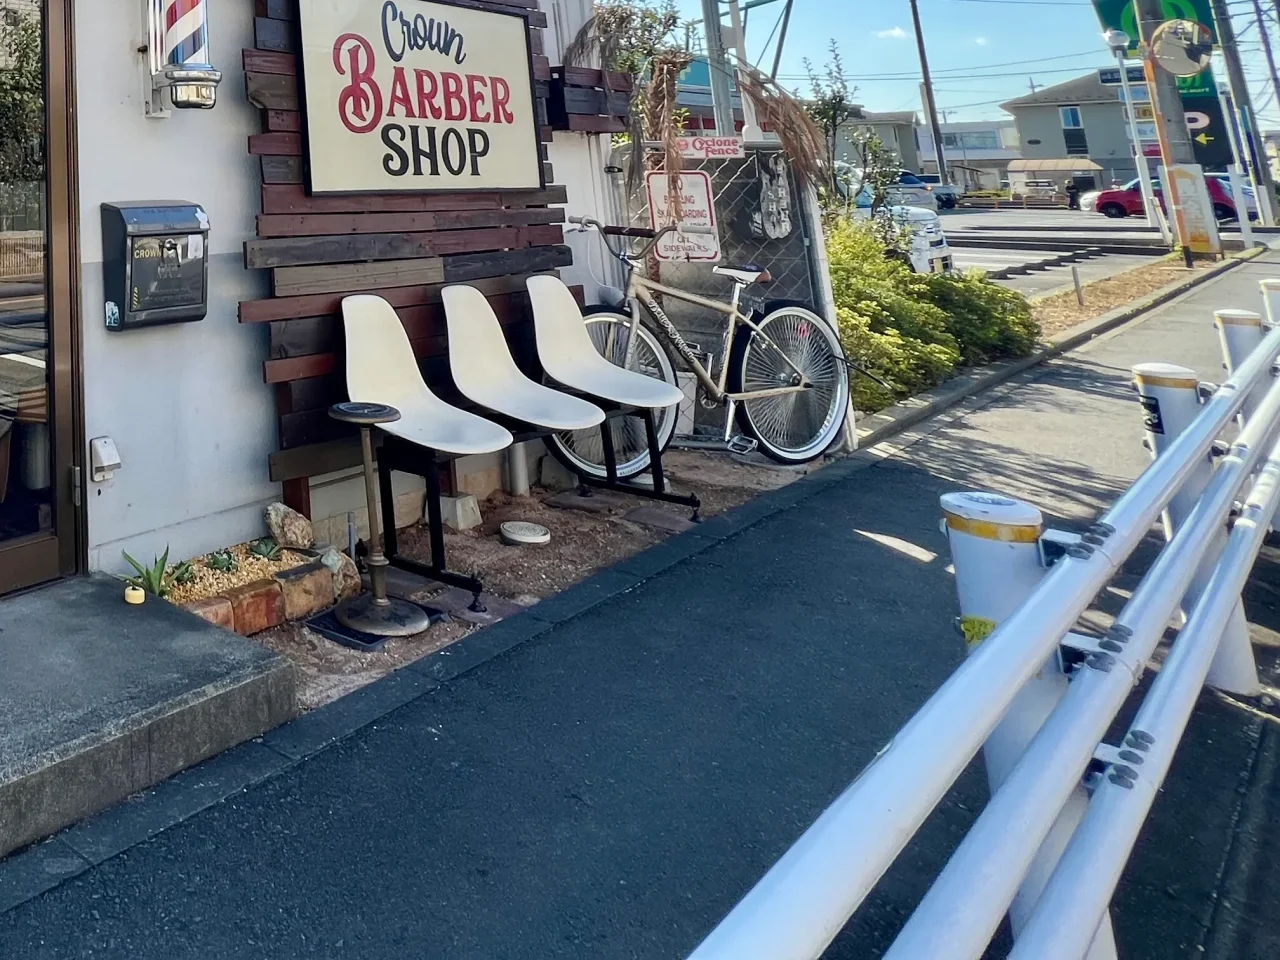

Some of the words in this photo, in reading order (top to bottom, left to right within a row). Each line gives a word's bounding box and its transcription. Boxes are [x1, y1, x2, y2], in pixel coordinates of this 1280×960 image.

[381, 0, 467, 65] Crown
[332, 32, 515, 135] BARBER
[380, 123, 490, 177] SHOP
[692, 137, 739, 151] Cyclone
[704, 146, 739, 158] Fence
[134, 249, 162, 259] CROWN
